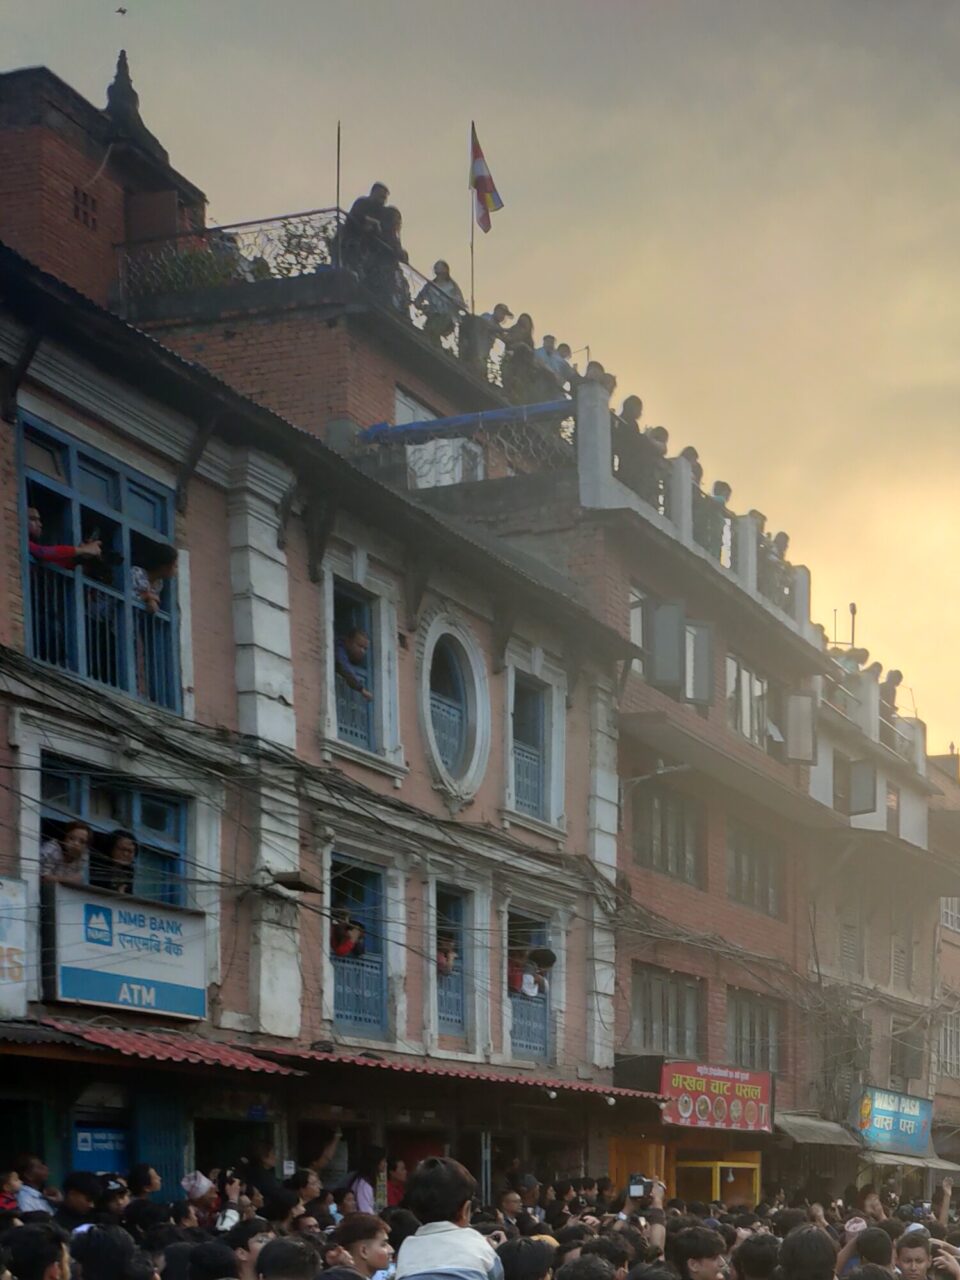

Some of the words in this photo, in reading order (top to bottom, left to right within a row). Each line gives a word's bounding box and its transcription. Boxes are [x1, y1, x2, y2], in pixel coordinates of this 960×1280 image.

[118, 910, 145, 928] NMB
[150, 917, 183, 936] BANK
[118, 982, 156, 1006] ATM
[874, 1092, 899, 1112] WASA
[900, 1097, 920, 1116] PASA
